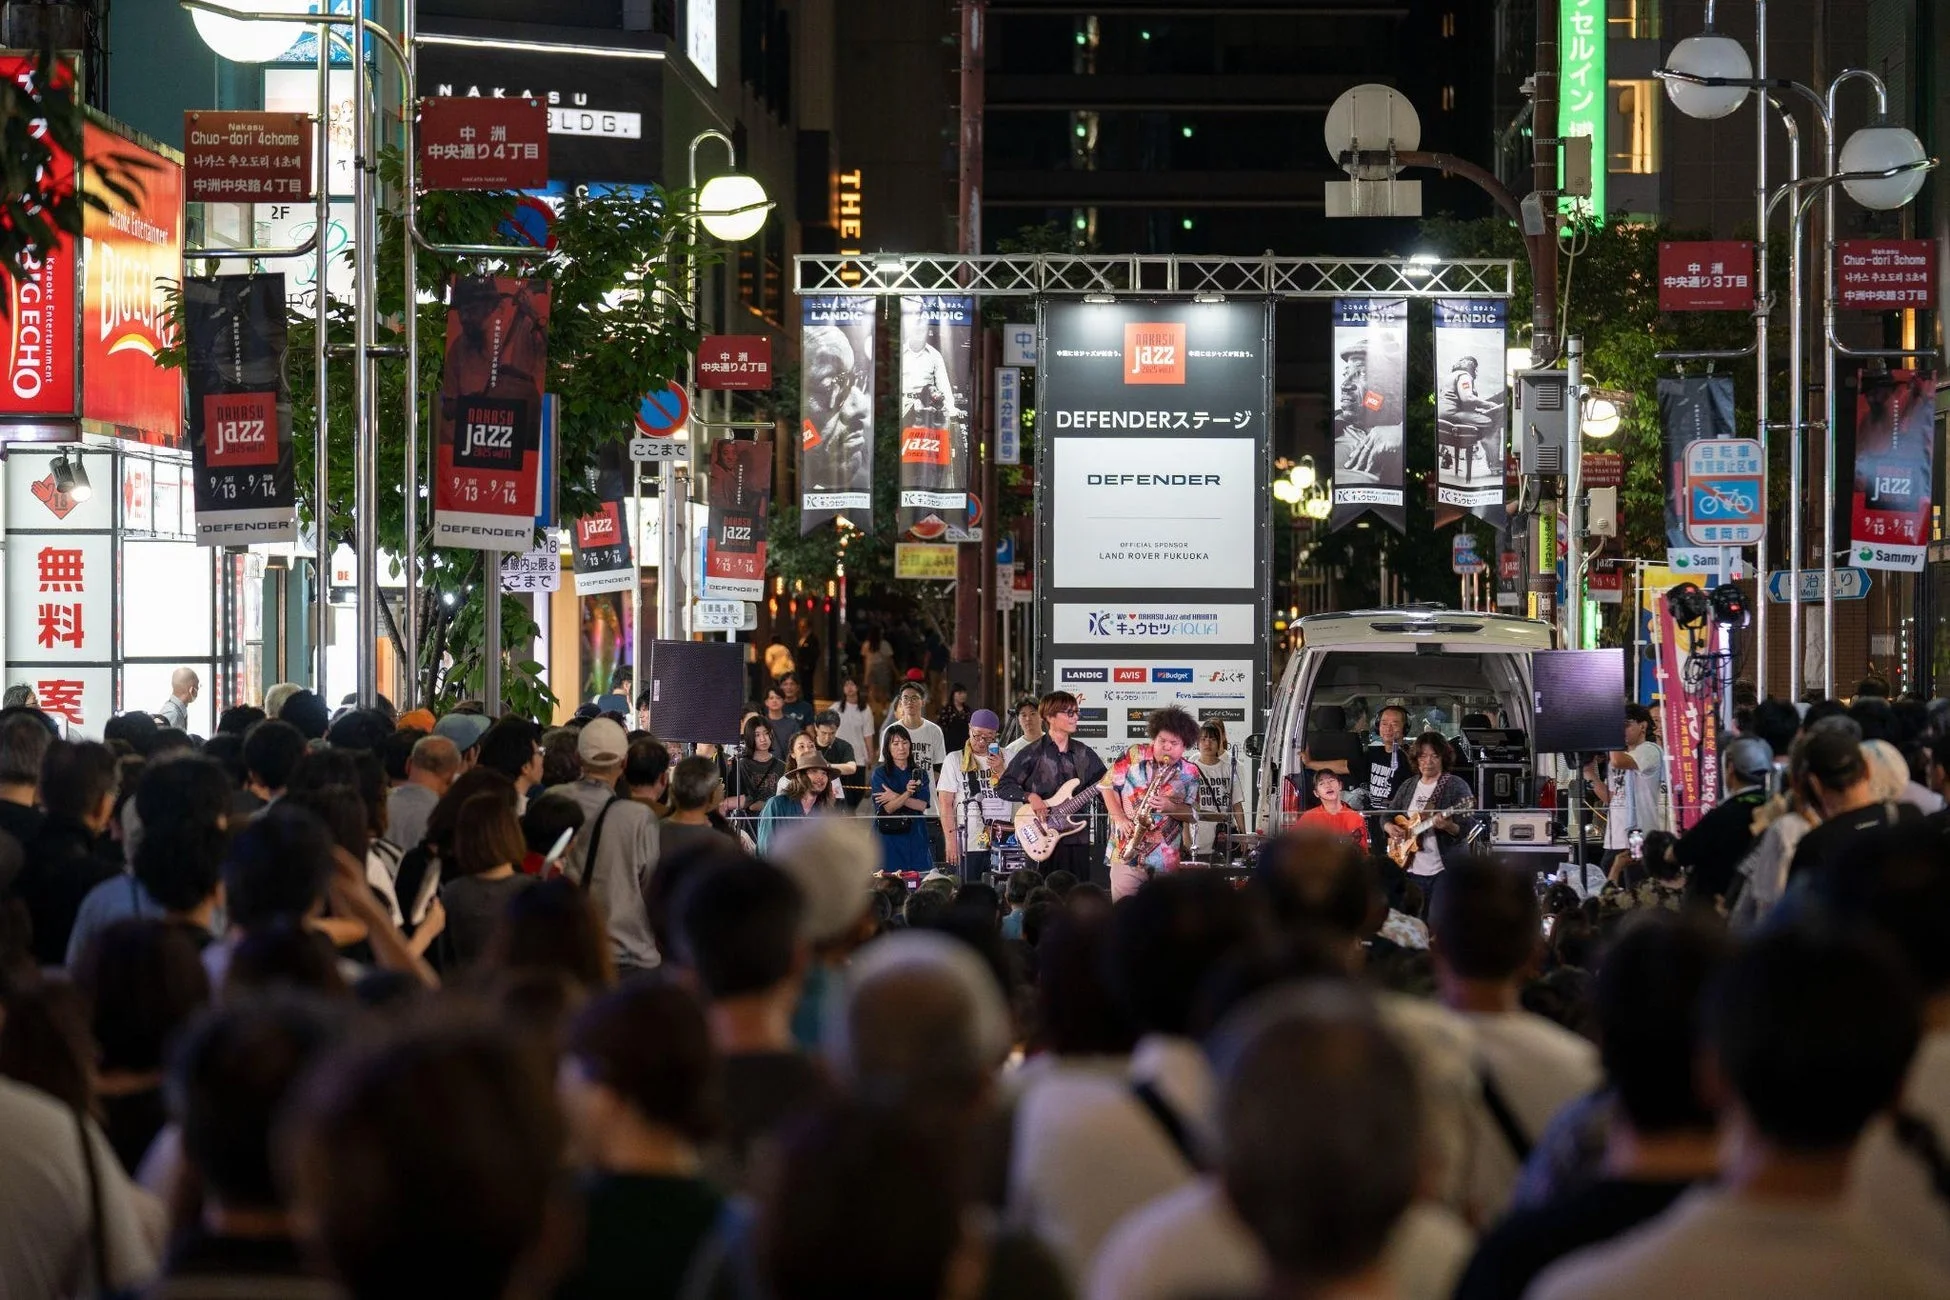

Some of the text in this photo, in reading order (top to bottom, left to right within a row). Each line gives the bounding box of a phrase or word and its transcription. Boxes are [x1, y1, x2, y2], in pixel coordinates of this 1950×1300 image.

[438, 84, 588, 106] NAKASU
[228, 122, 264, 132] Nakasu
[191, 132, 299, 145] Chuo-dori 4chome
[428, 143, 539, 160] 中央通り4丁目
[193, 154, 226, 169] 나카스
[228, 154, 270, 169] 주오도리
[841, 169, 860, 239] THE
[272, 206, 290, 220] 2F
[1843, 255, 1926, 266] Chuo-dori 3chome
[46, 257, 55, 384] Karaoke Entertainment
[811, 311, 864, 321] LANDIC
[918, 311, 964, 321] ANDIC
[1342, 312, 1395, 323] LANDIC
[1444, 313, 1497, 324] LANDIC
[13, 309, 42, 399] ECHO
[1132, 346, 1175, 374] jazz
[215, 420, 265, 454] jazz
[461, 424, 513, 457] jazz
[633, 443, 687, 456] ここまで
[902, 437, 940, 457] jazz
[1701, 445, 1750, 459] 自転車
[1088, 474, 1221, 486] DEFENDER
[1871, 476, 1912, 502] jazz
[202, 520, 290, 533] DEFENDER
[441, 523, 526, 538] DEFENDER
[583, 518, 613, 541] jazz
[720, 525, 751, 546] jazz
[1704, 527, 1749, 541] 福岡市
[1099, 552, 1209, 560] LAND ROVER FUKUOKA
[1875, 549, 1918, 566] Sammy
[580, 576, 632, 588] DEFENDER
[709, 583, 760, 593] DEFENDER
[703, 615, 739, 625] ここまで
[1165, 613, 1179, 621] Jazz
[1066, 671, 1103, 679] LANDIC
[1119, 671, 1141, 679] AVIS
[1166, 672, 1188, 680] Budget
[1219, 672, 1246, 683] ふくや
